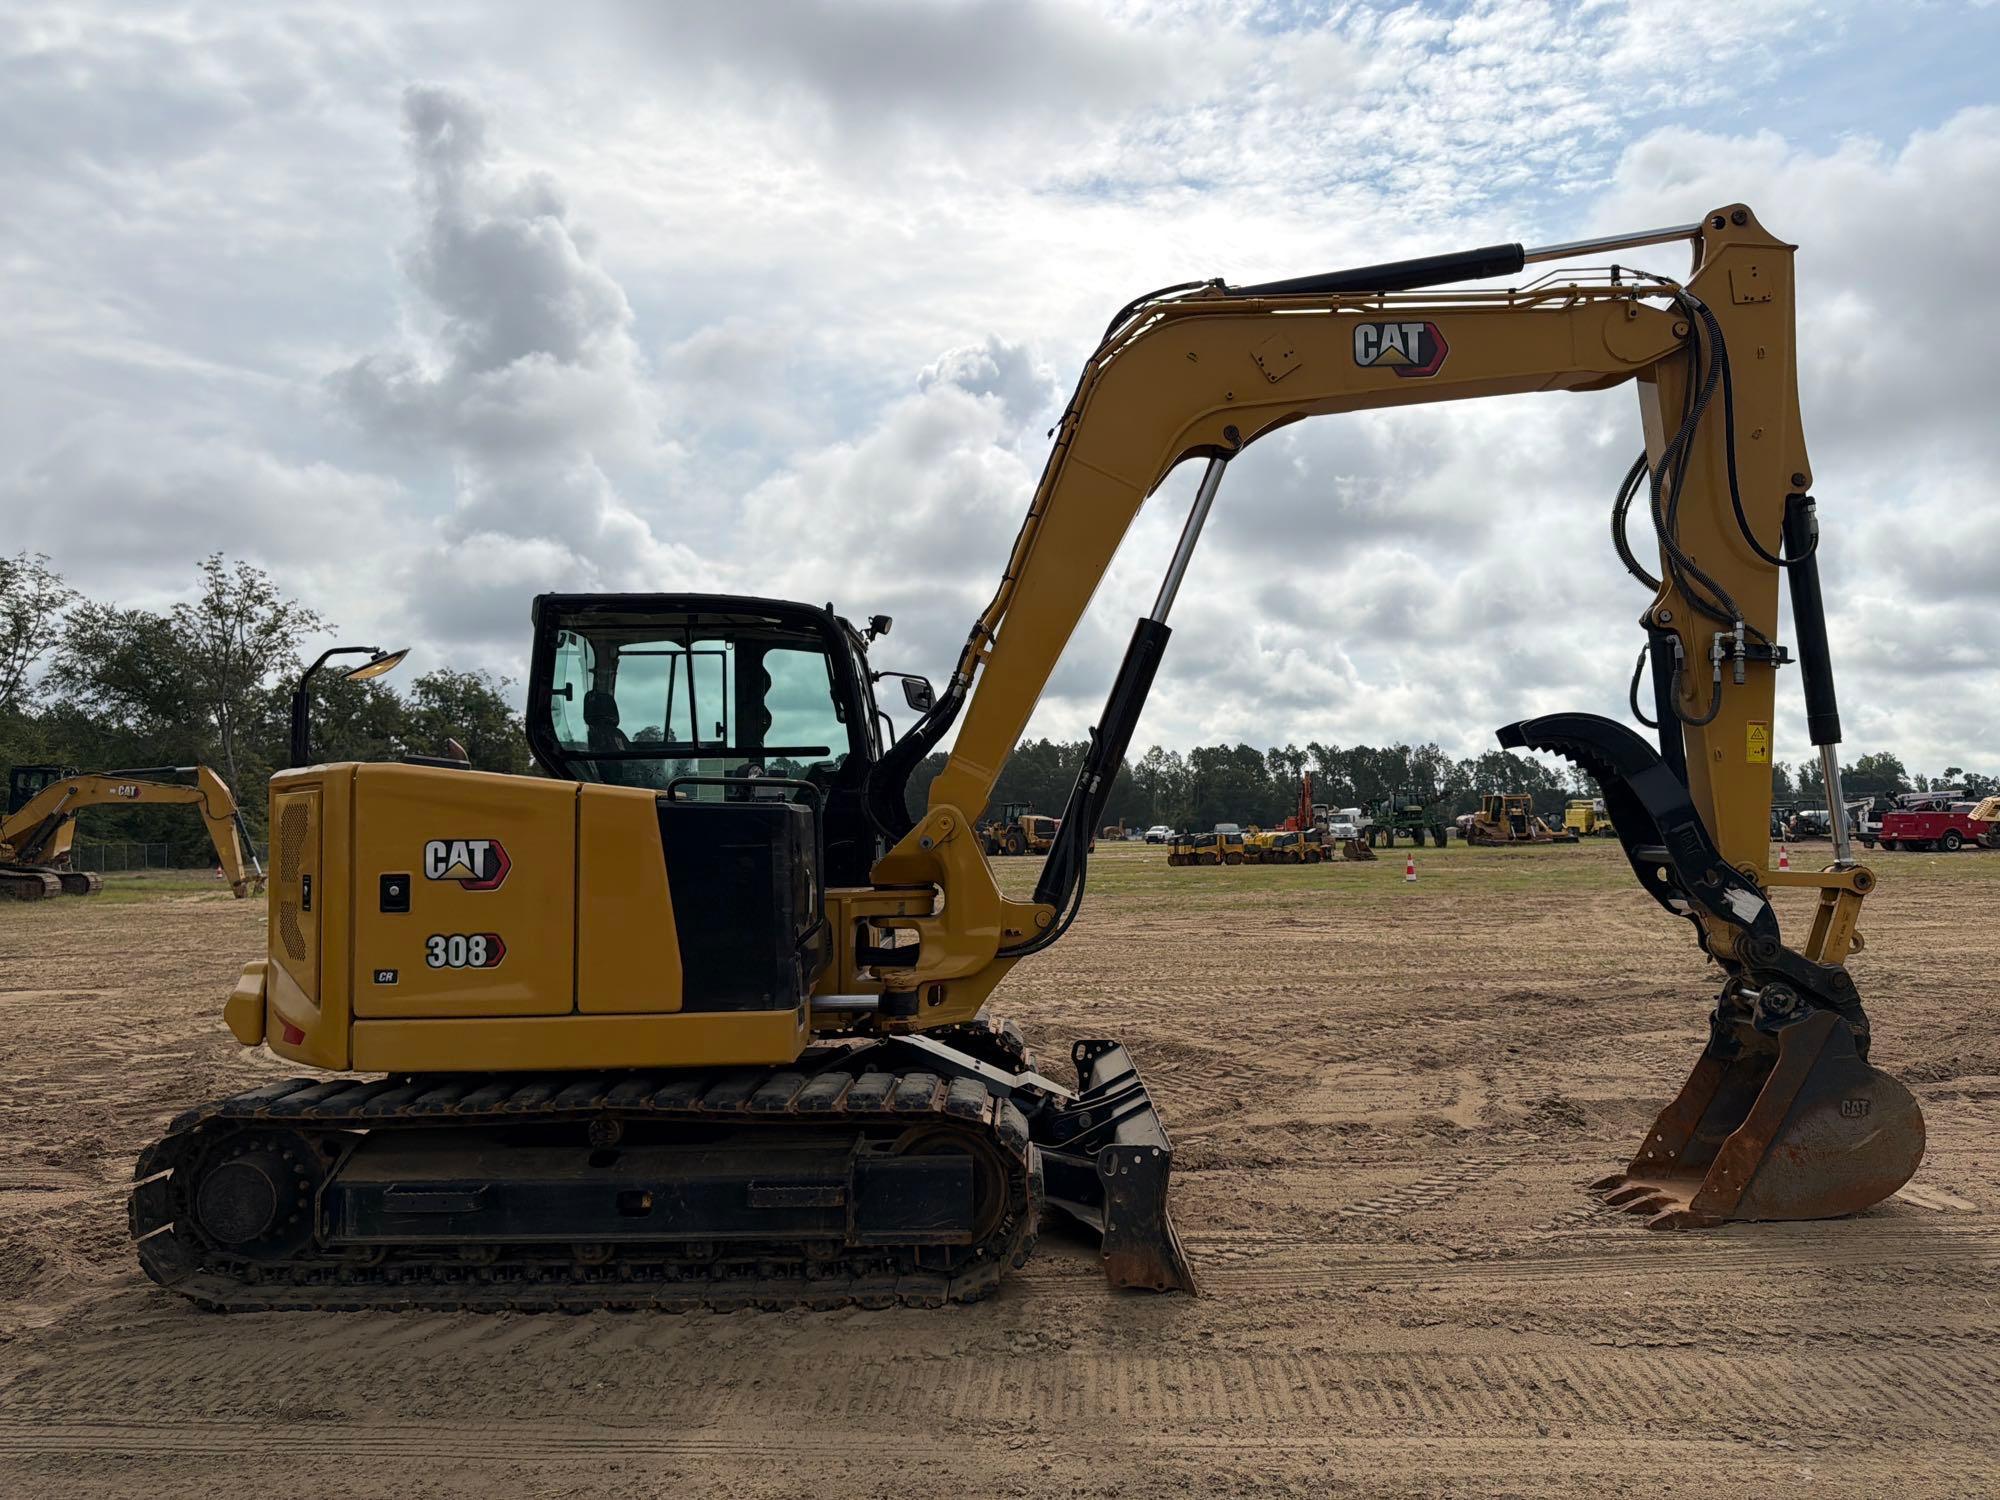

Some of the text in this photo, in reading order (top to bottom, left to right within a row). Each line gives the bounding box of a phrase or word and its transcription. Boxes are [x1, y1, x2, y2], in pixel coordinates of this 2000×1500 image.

[1355, 323, 1424, 366] CAT
[118, 785, 136, 797] CAT
[425, 840, 490, 879] CAT
[427, 935, 487, 967] 308
[378, 971, 394, 982] CR
